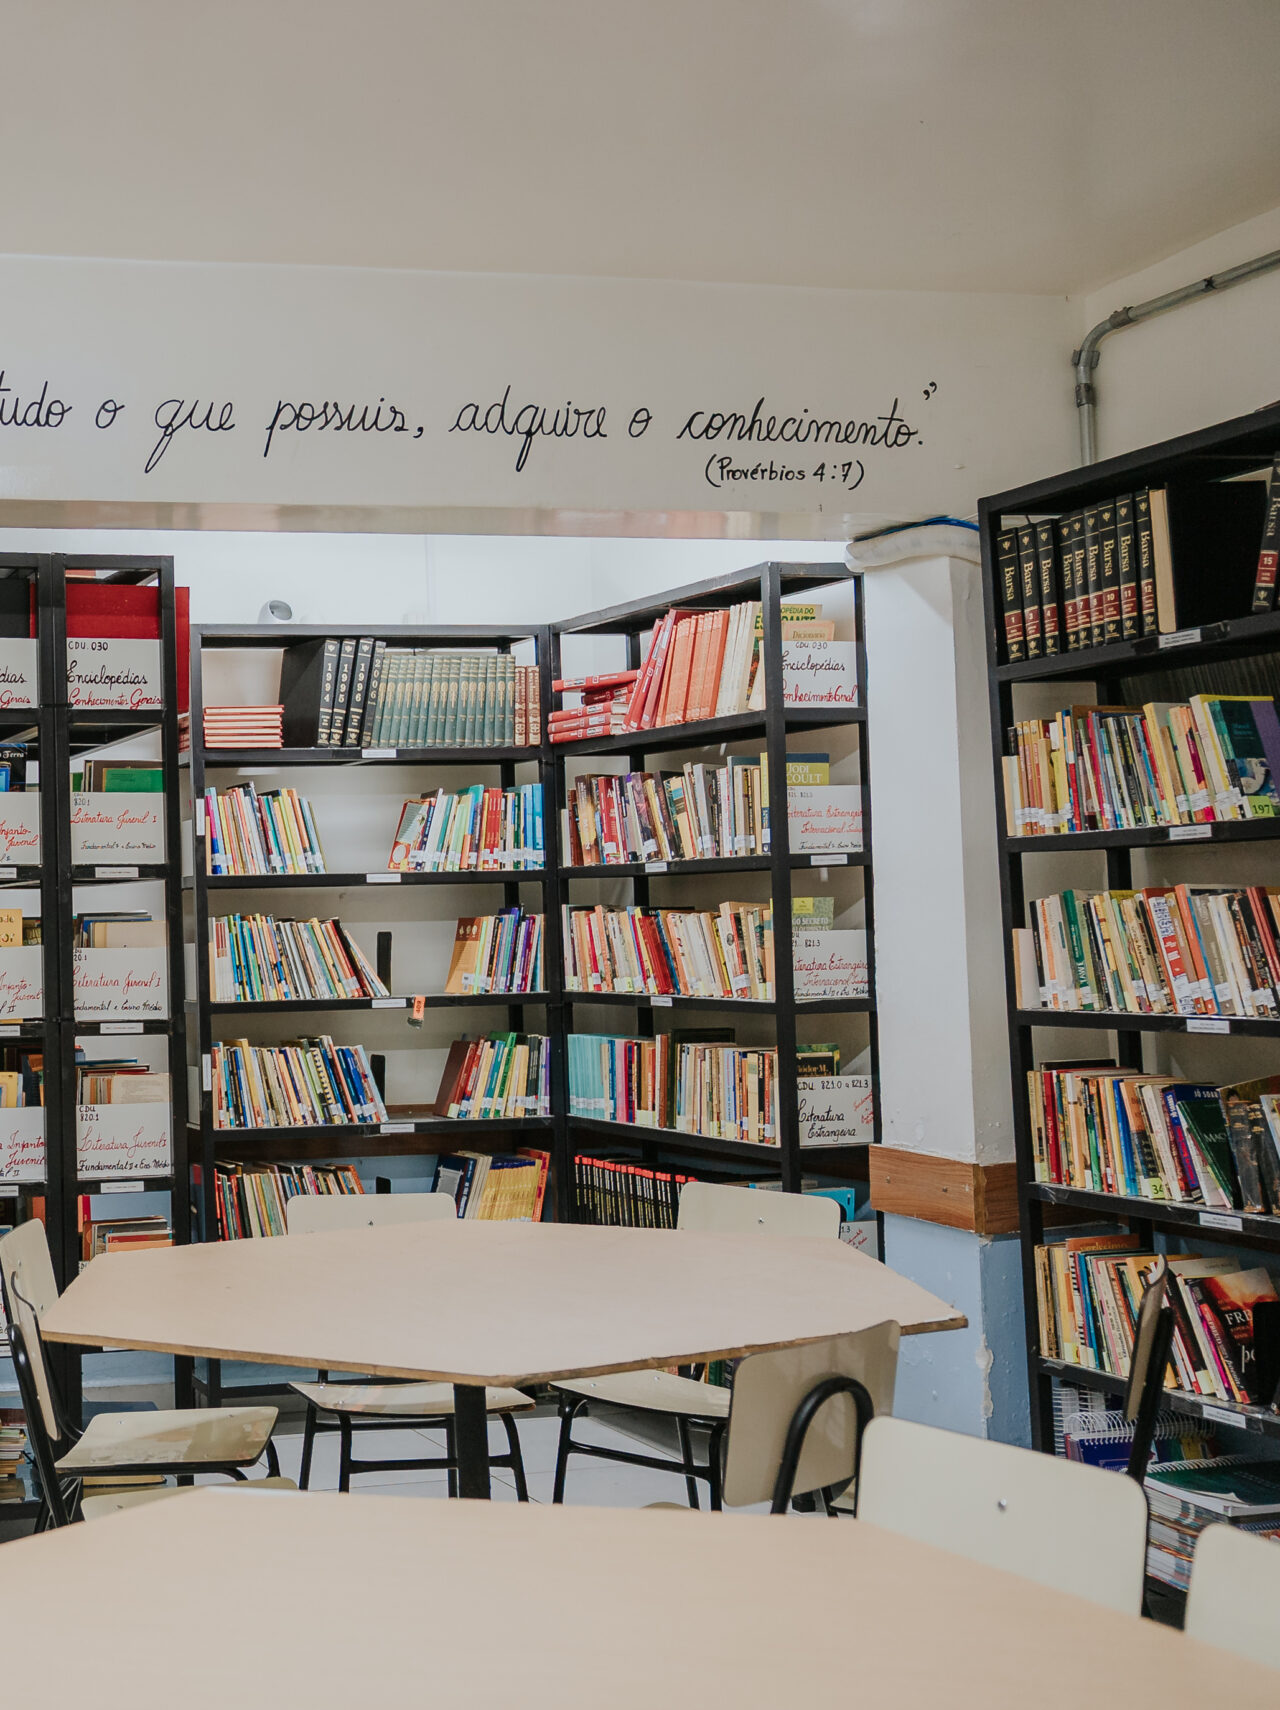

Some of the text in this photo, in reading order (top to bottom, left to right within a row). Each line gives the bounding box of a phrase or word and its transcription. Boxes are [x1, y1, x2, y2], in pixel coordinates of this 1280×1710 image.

[95, 398, 126, 429] o
[144, 398, 237, 474] que
[266, 397, 425, 458] possuis,
[448, 385, 608, 472] adquire
[628, 407, 653, 437] o
[1075, 549, 1084, 585] Barsa
[1088, 545, 1099, 581] Barsa
[1103, 540, 1115, 576] Barsa
[1121, 535, 1131, 571] Barsa
[1140, 531, 1150, 568] Barsa
[1004, 567, 1015, 601] Barsa
[1023, 561, 1033, 597] Barsa
[1041, 558, 1051, 594] Barsa
[1063, 554, 1072, 589] Barsa
[91, 641, 108, 651] 030
[67, 660, 148, 690] Enciclopédias
[324, 663, 332, 702] 1994
[338, 664, 348, 703] 1995
[355, 663, 365, 702] 1996
[370, 659, 381, 698] 2006
